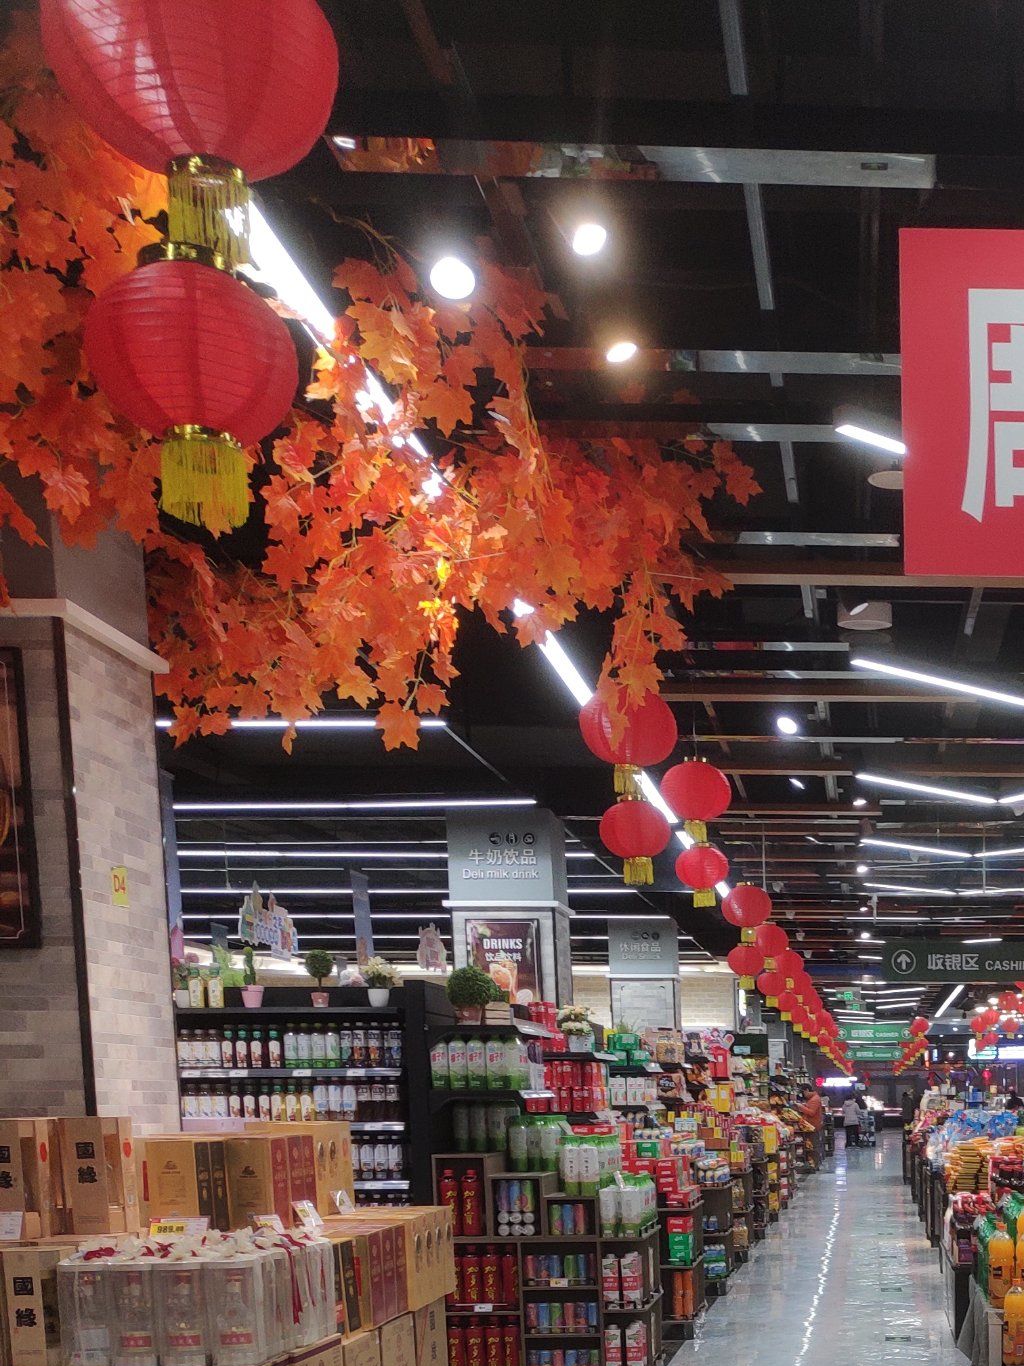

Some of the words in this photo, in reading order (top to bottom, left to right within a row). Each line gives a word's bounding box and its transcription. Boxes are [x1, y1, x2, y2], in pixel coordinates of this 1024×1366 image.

[468, 849, 537, 866] 牛奶饮品
[483, 938, 523, 950] DRINKS
[928, 954, 979, 971] 收银区
